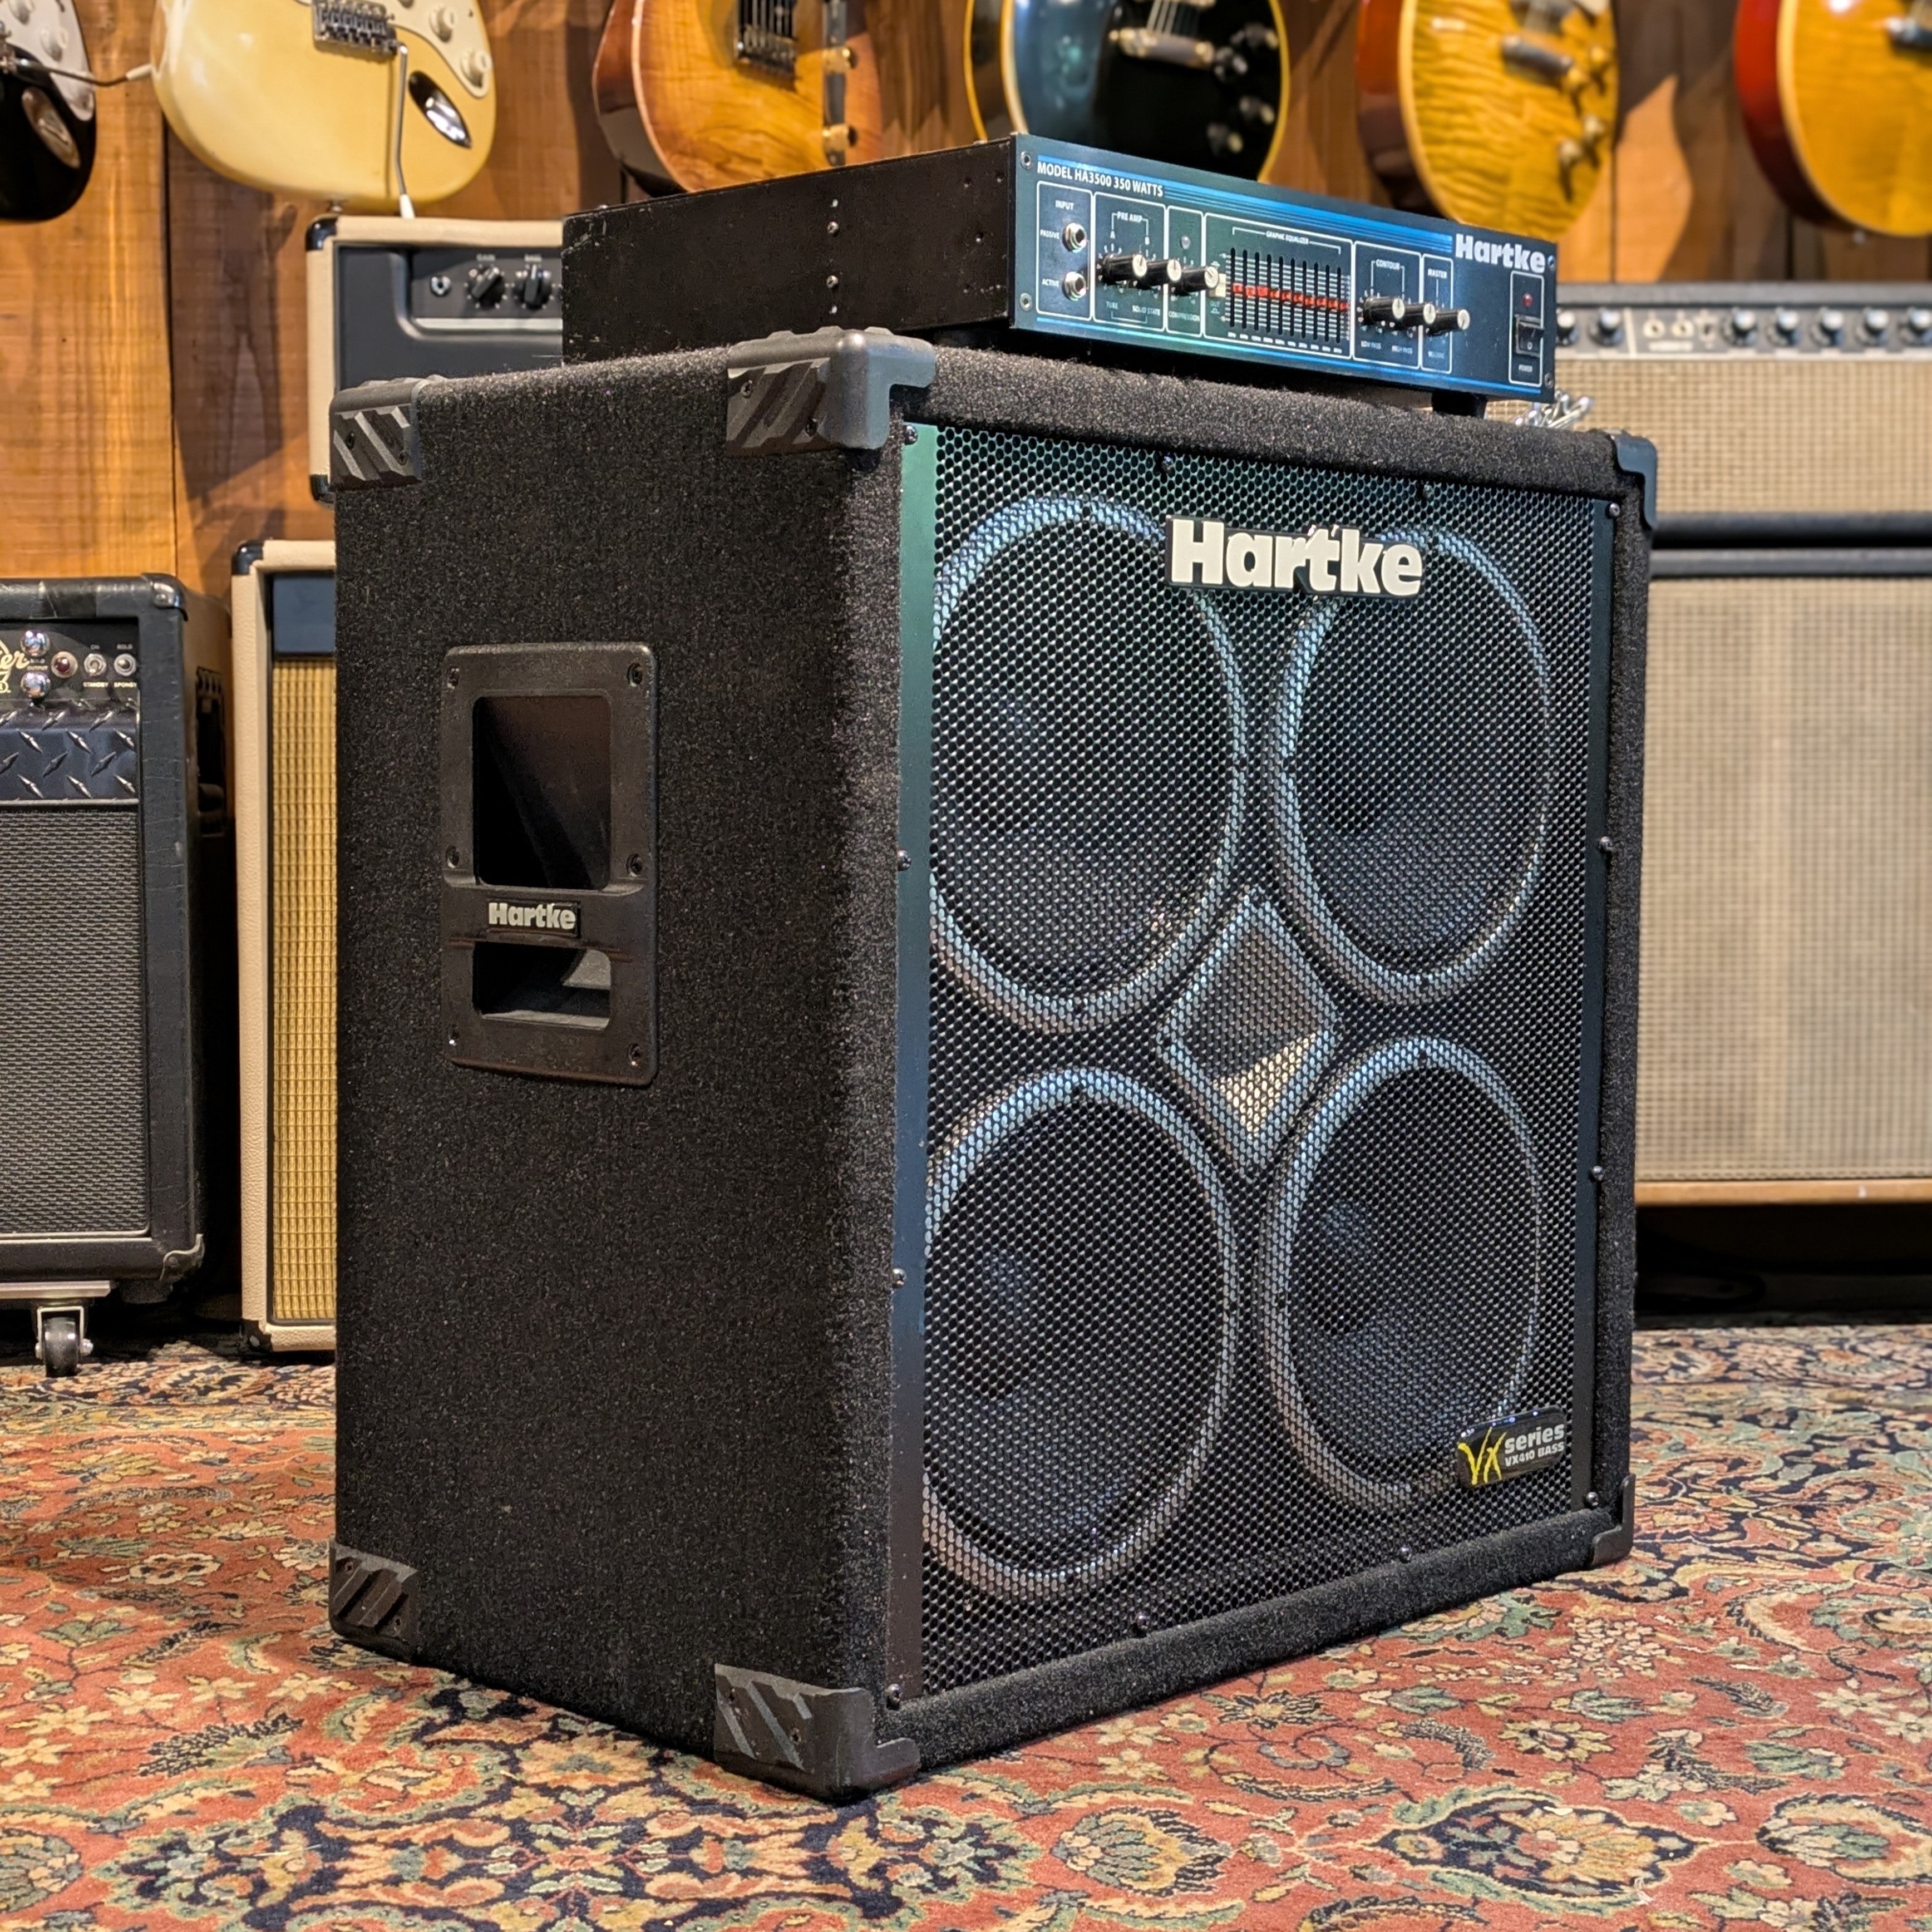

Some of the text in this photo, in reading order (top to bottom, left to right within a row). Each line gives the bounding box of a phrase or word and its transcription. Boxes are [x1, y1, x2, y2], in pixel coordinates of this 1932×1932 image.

[1037, 161, 1164, 198] MODEL HA3500 350 WATTS
[1055, 200, 1075, 211] INPUT
[1117, 211, 1143, 223] PRE AMP
[1110, 230, 1116, 239] A
[1455, 233, 1546, 273] Hartke
[1376, 259, 1400, 270] CONTOUR
[1041, 278, 1060, 288] ACTIVE
[1106, 300, 1118, 309] TUBE
[1171, 519, 1423, 597] Hartke
[488, 902, 576, 930] Hartke
[1504, 1423, 1565, 1455] series
[1505, 1441, 1565, 1467] VX410 BASS
